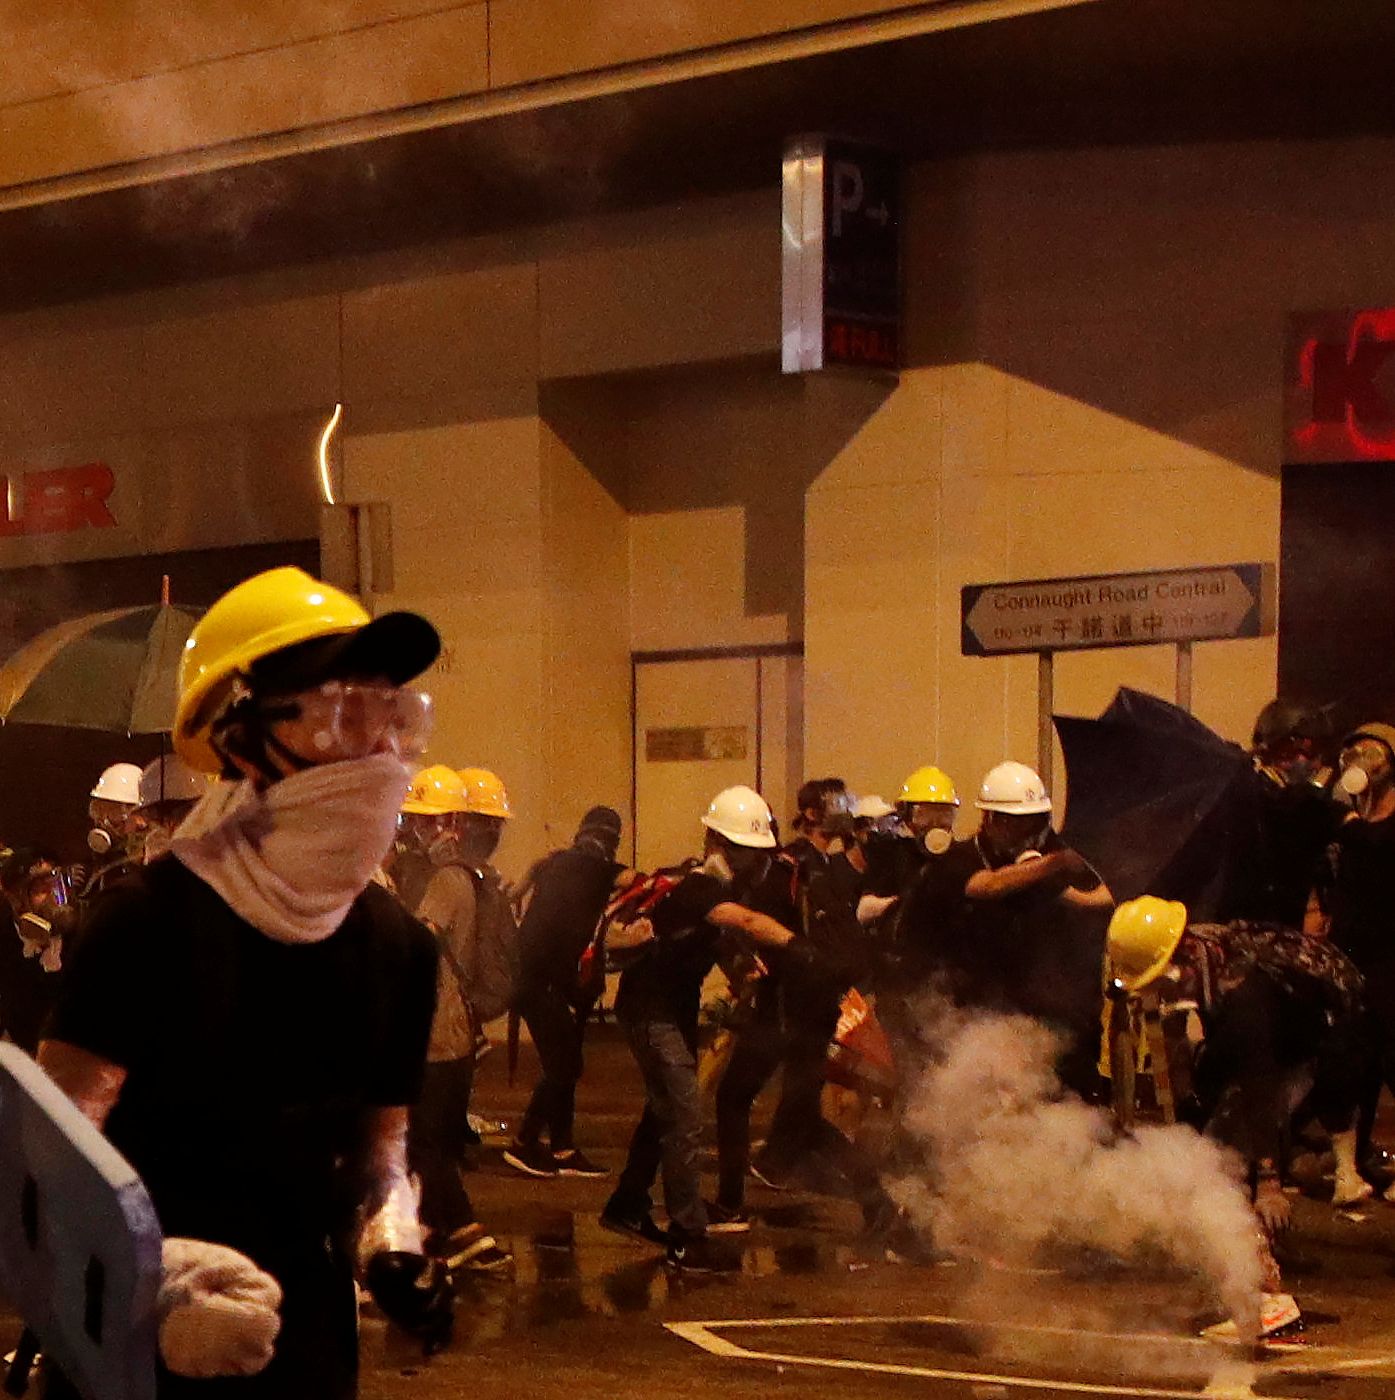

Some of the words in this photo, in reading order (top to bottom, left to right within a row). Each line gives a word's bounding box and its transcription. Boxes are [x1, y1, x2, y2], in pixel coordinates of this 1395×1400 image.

[832, 160, 863, 238] P
[993, 587, 1091, 611] Connaught
[1098, 583, 1148, 602] Road
[1155, 577, 1226, 600] Central
